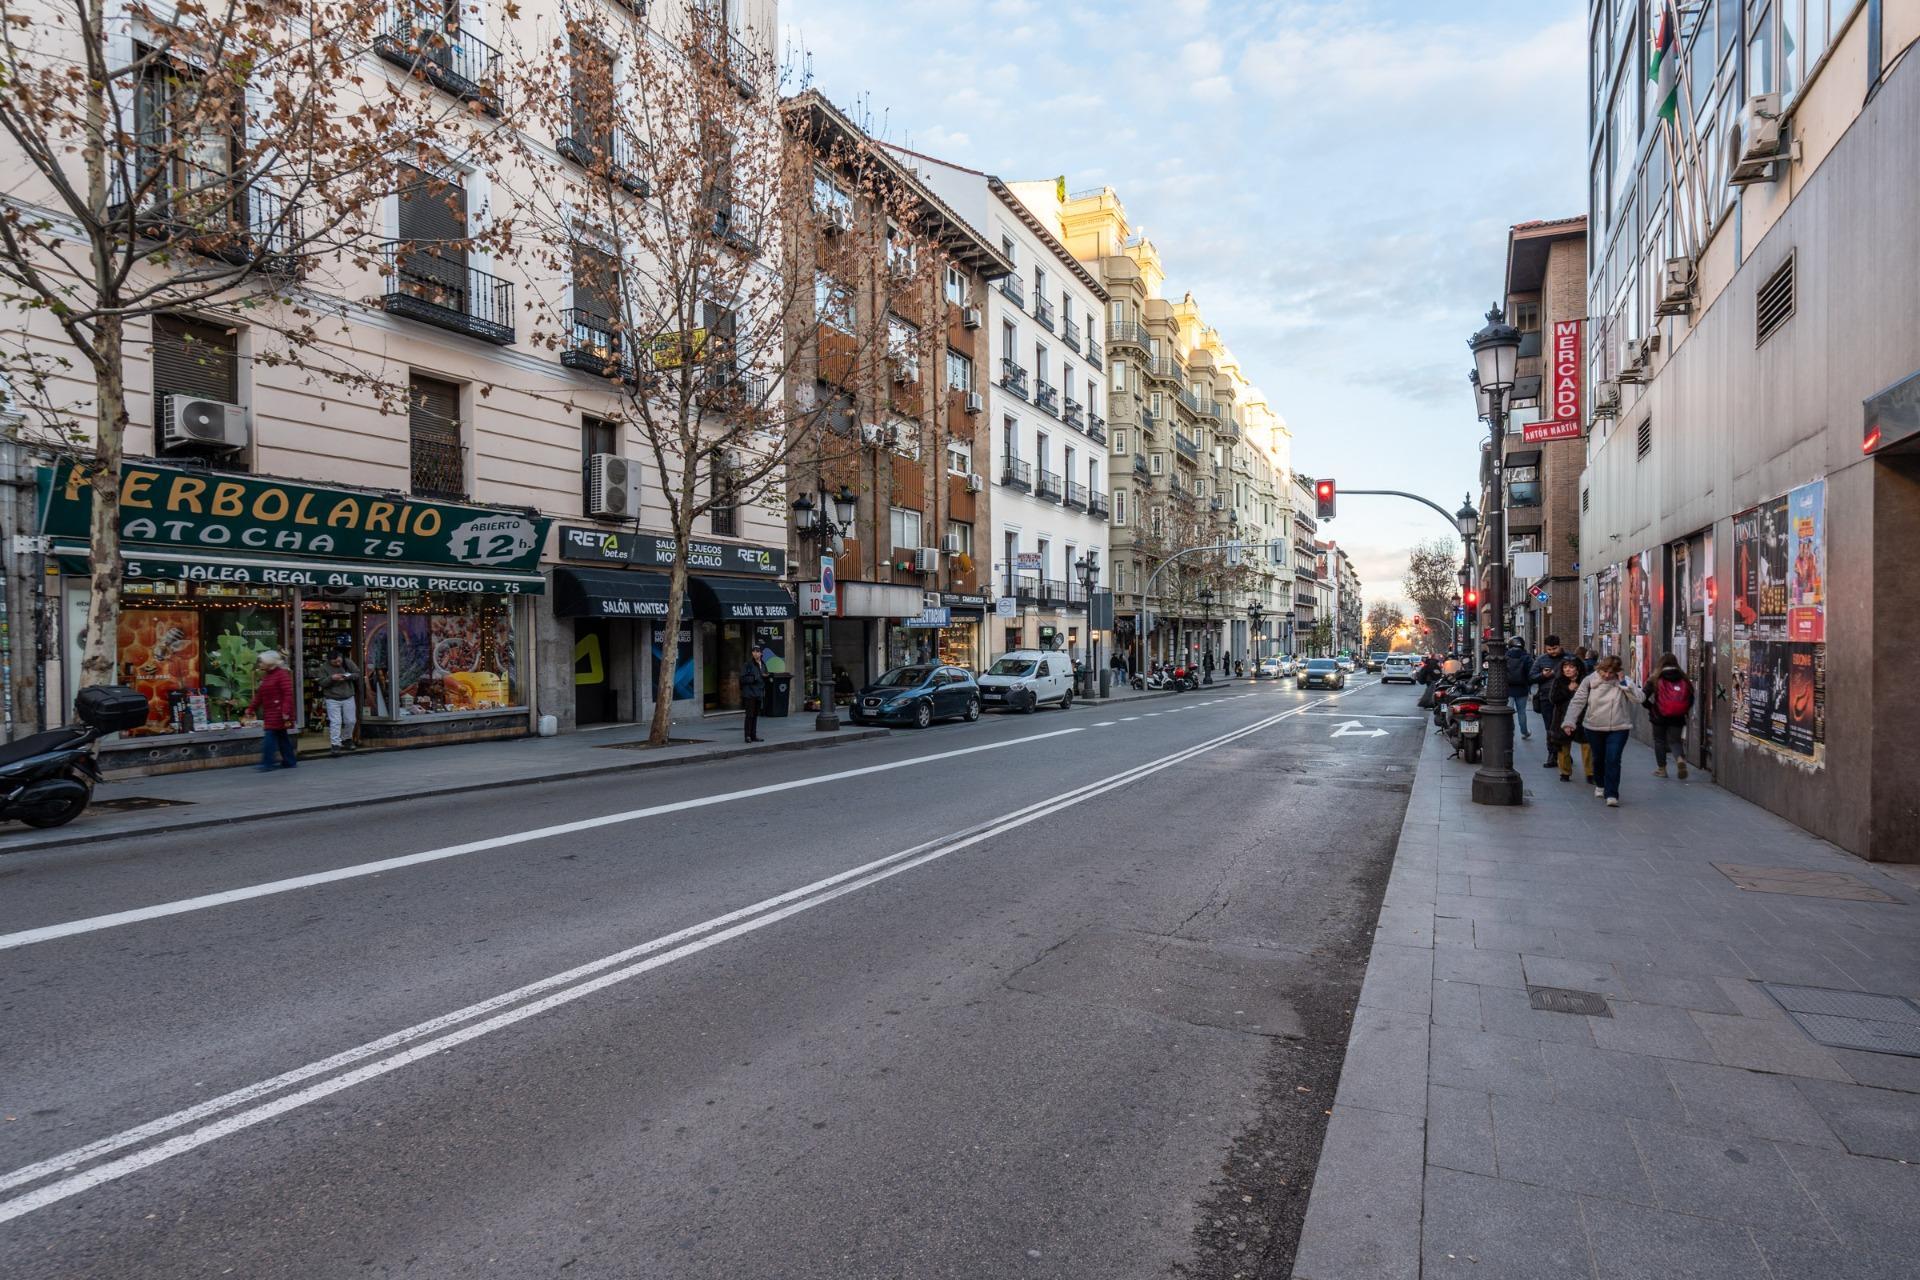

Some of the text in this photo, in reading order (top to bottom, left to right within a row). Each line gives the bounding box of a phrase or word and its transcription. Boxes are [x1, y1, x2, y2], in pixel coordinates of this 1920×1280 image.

[1557, 323, 1577, 417] MERCADO
[1525, 421, 1578, 441] ANTÓN MARTÍN
[470, 520, 520, 532] ABIERTO
[1735, 519, 1758, 543] TOSCA
[123, 518, 405, 558] ATOCHA 75
[461, 534, 514, 560] 12
[568, 530, 618, 551] RETA
[656, 539, 677, 550] SALÓ
[694, 545, 722, 555] JUEGOS
[604, 550, 628, 560] bet.es
[737, 548, 770, 564] RETA
[180, 564, 250, 582] JALEA
[263, 569, 316, 586] REAL
[328, 573, 354, 586] AL
[363, 574, 420, 590] MEJOR
[428, 578, 484, 593] PRECIO
[504, 583, 520, 593] 75
[602, 599, 631, 614] SALÓN
[732, 604, 788, 617] SALÓN DE JUEGOS
